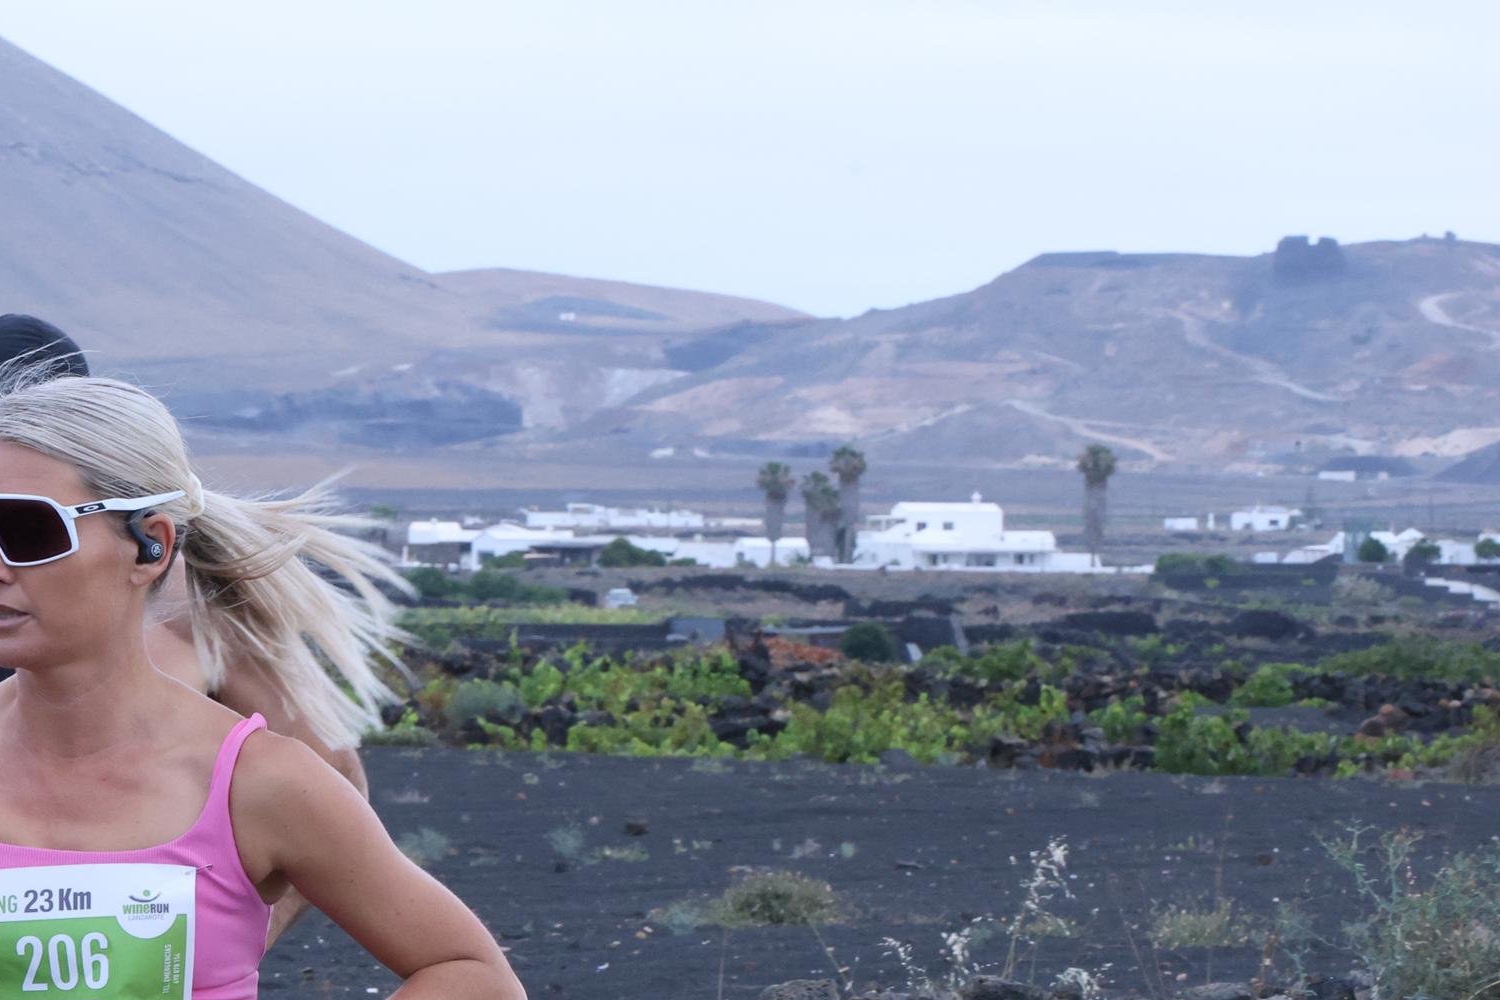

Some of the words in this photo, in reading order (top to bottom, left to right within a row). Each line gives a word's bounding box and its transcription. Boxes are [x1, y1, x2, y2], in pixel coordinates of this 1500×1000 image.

[24, 888, 54, 914] 23
[59, 887, 92, 911] Km
[16, 931, 110, 992] 206
